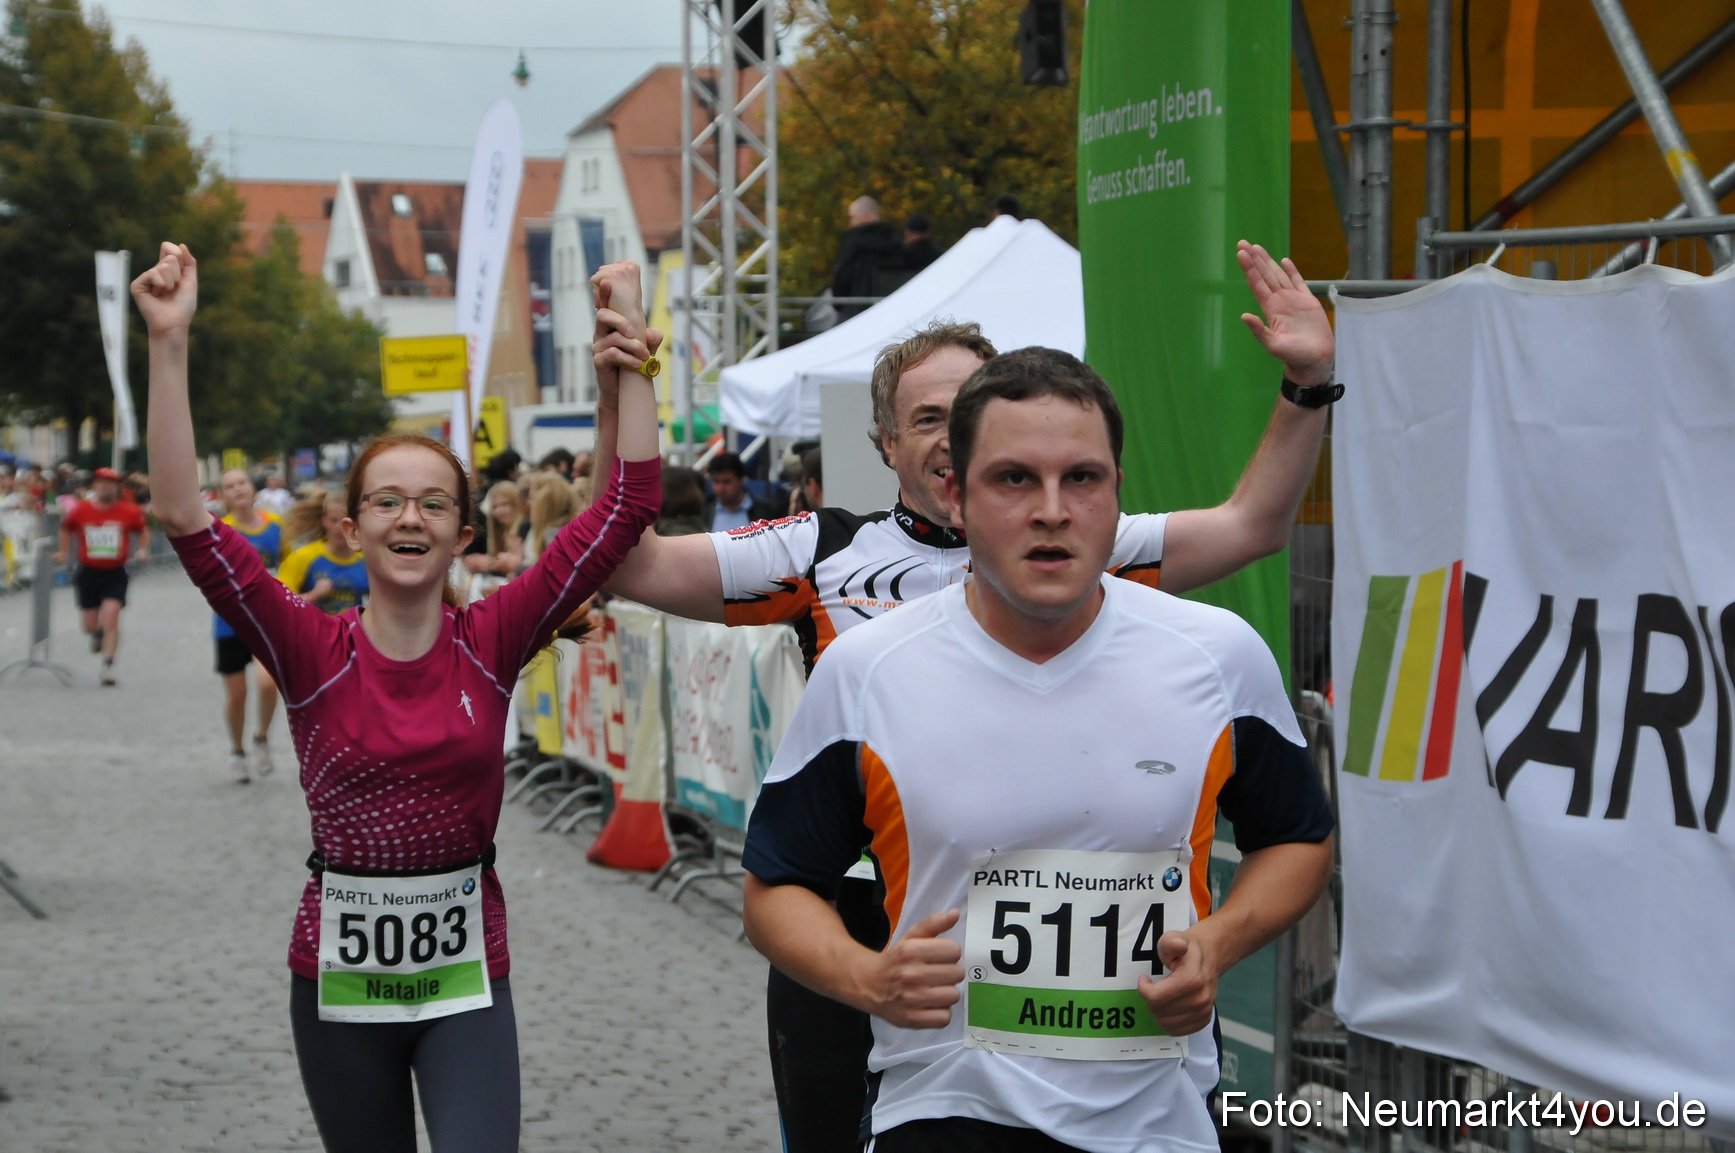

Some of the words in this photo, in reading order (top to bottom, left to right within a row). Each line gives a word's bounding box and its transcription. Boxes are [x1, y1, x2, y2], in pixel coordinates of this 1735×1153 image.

[1162, 81, 1223, 124] leben.
[1126, 149, 1191, 196] schaffen.
[473, 419, 494, 449] A
[974, 869, 1048, 889] PARTL
[1055, 871, 1154, 891] Neumarkt
[325, 887, 378, 906] PARTL
[383, 886, 457, 906] Neumarkt
[338, 905, 467, 967] 5083
[990, 900, 1165, 978] 5114
[974, 968, 982, 979] S
[366, 978, 440, 1001] Natalie
[1018, 997, 1136, 1029] Andreas
